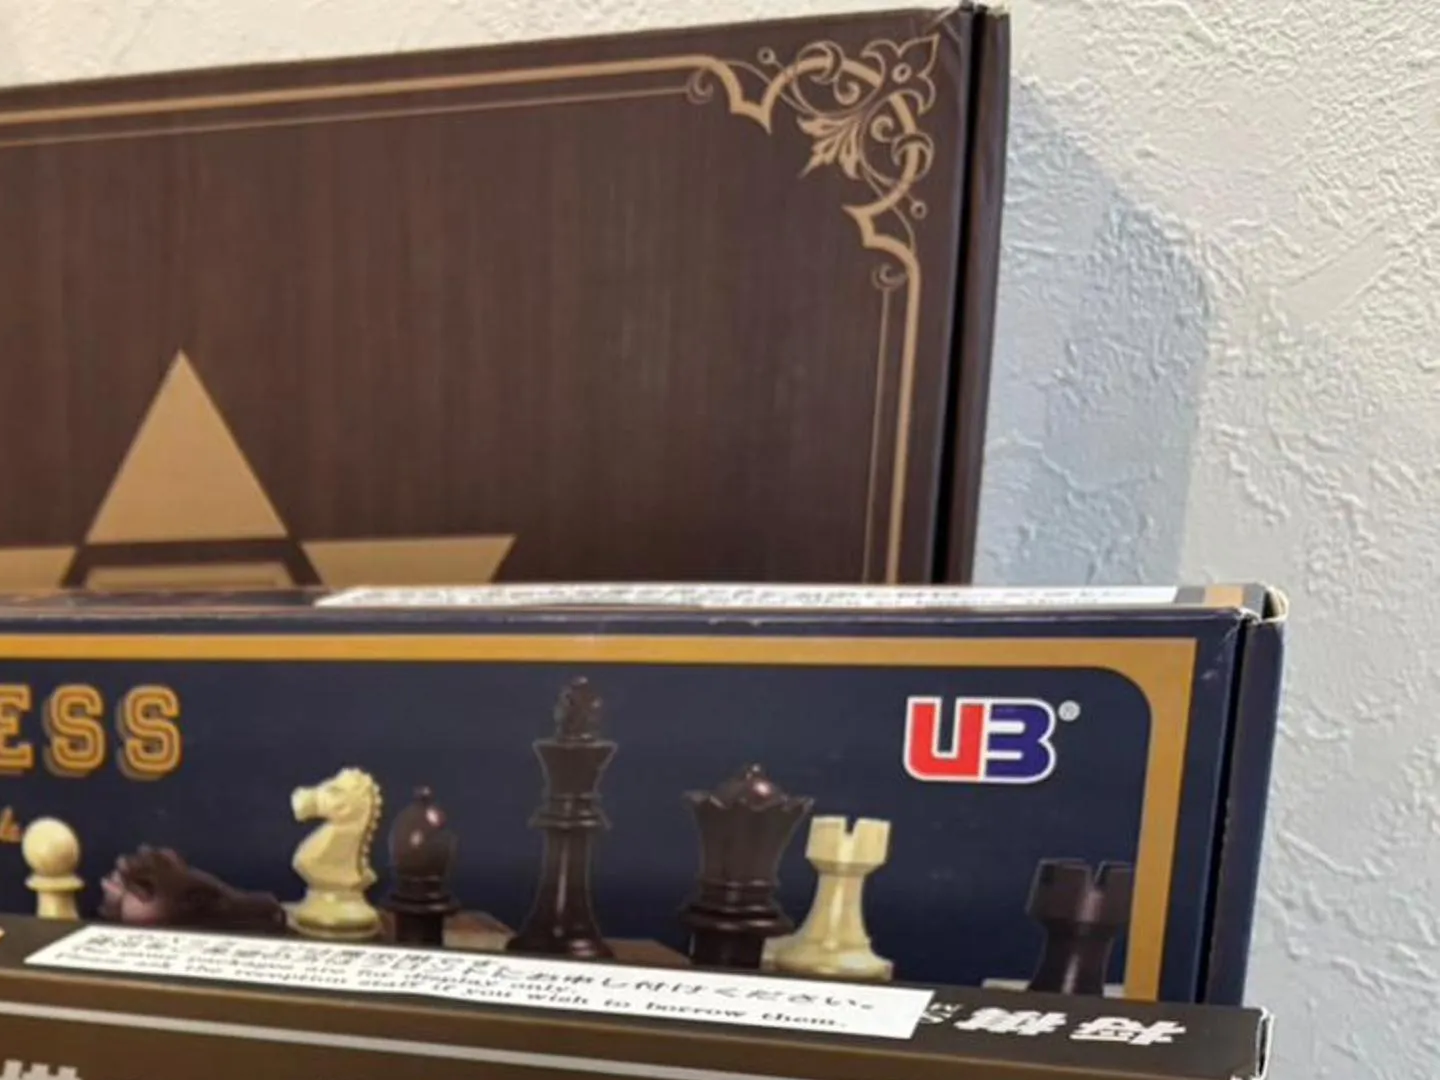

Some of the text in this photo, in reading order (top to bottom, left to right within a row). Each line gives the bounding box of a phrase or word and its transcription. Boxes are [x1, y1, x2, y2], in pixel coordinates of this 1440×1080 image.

[527, 992, 589, 1006] wish
[603, 997, 631, 1009] to
[645, 1001, 747, 1018] borrow
[761, 1010, 850, 1028] them.
